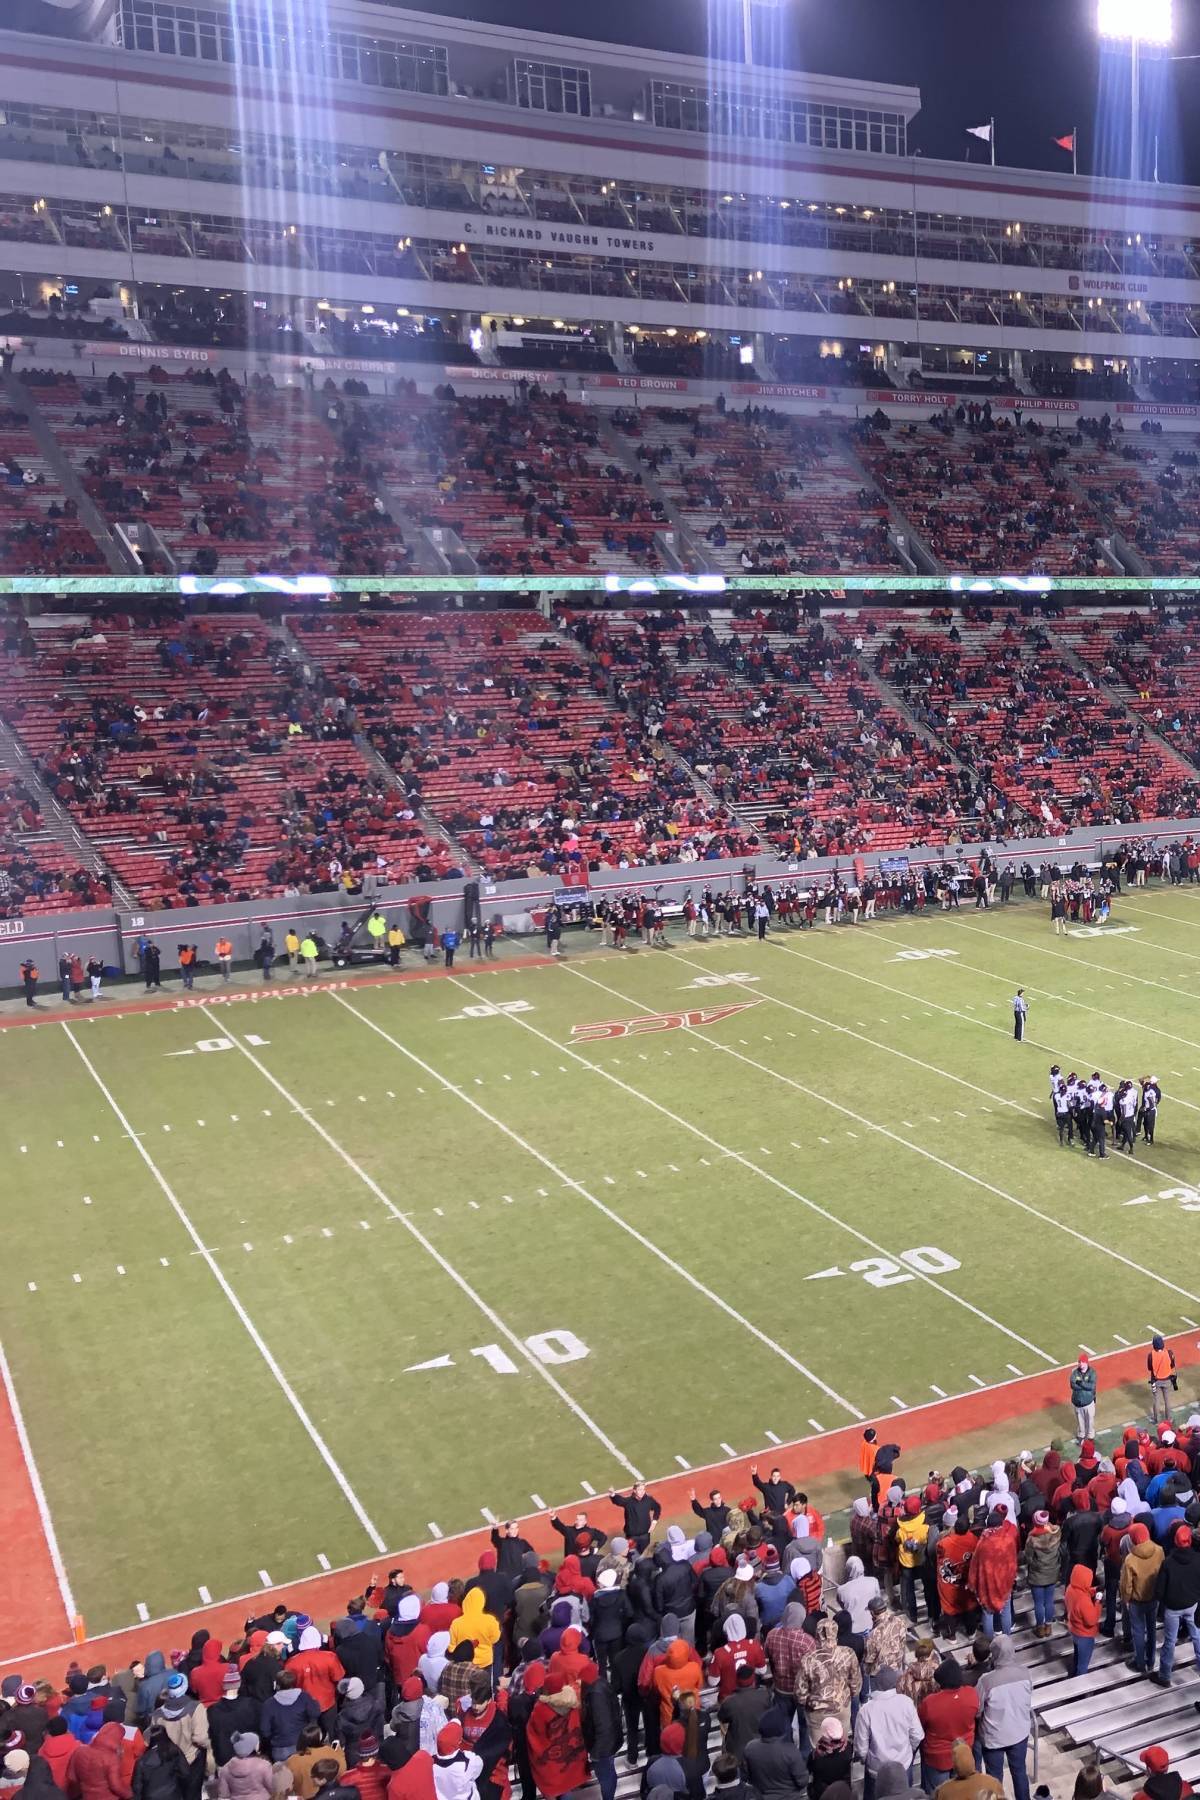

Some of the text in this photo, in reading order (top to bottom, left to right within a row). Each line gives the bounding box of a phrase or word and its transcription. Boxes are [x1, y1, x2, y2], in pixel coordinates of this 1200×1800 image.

[465, 223, 655, 251] C. RICHARD VAUGHN TOWERS
[1083, 279, 1125, 292] WOLFPACK
[1128, 283, 1148, 292] CLUB
[120, 346, 208, 361] DENNIS BYRD
[472, 369, 498, 380] DICK
[617, 377, 678, 390] TED BROWN
[757, 385, 818, 398] JIM RITCHER
[891, 393, 948, 405] TORRY HOLT
[1014, 400, 1076, 411] PHILIP RIVERS
[1132, 405, 1196, 416] MARIO WILLIAMS
[131, 917, 145, 927] 18
[461, 1000, 536, 1018] 20
[194, 1034, 272, 1053] 10
[849, 1246, 962, 1288] 20
[469, 1329, 592, 1373] 10
